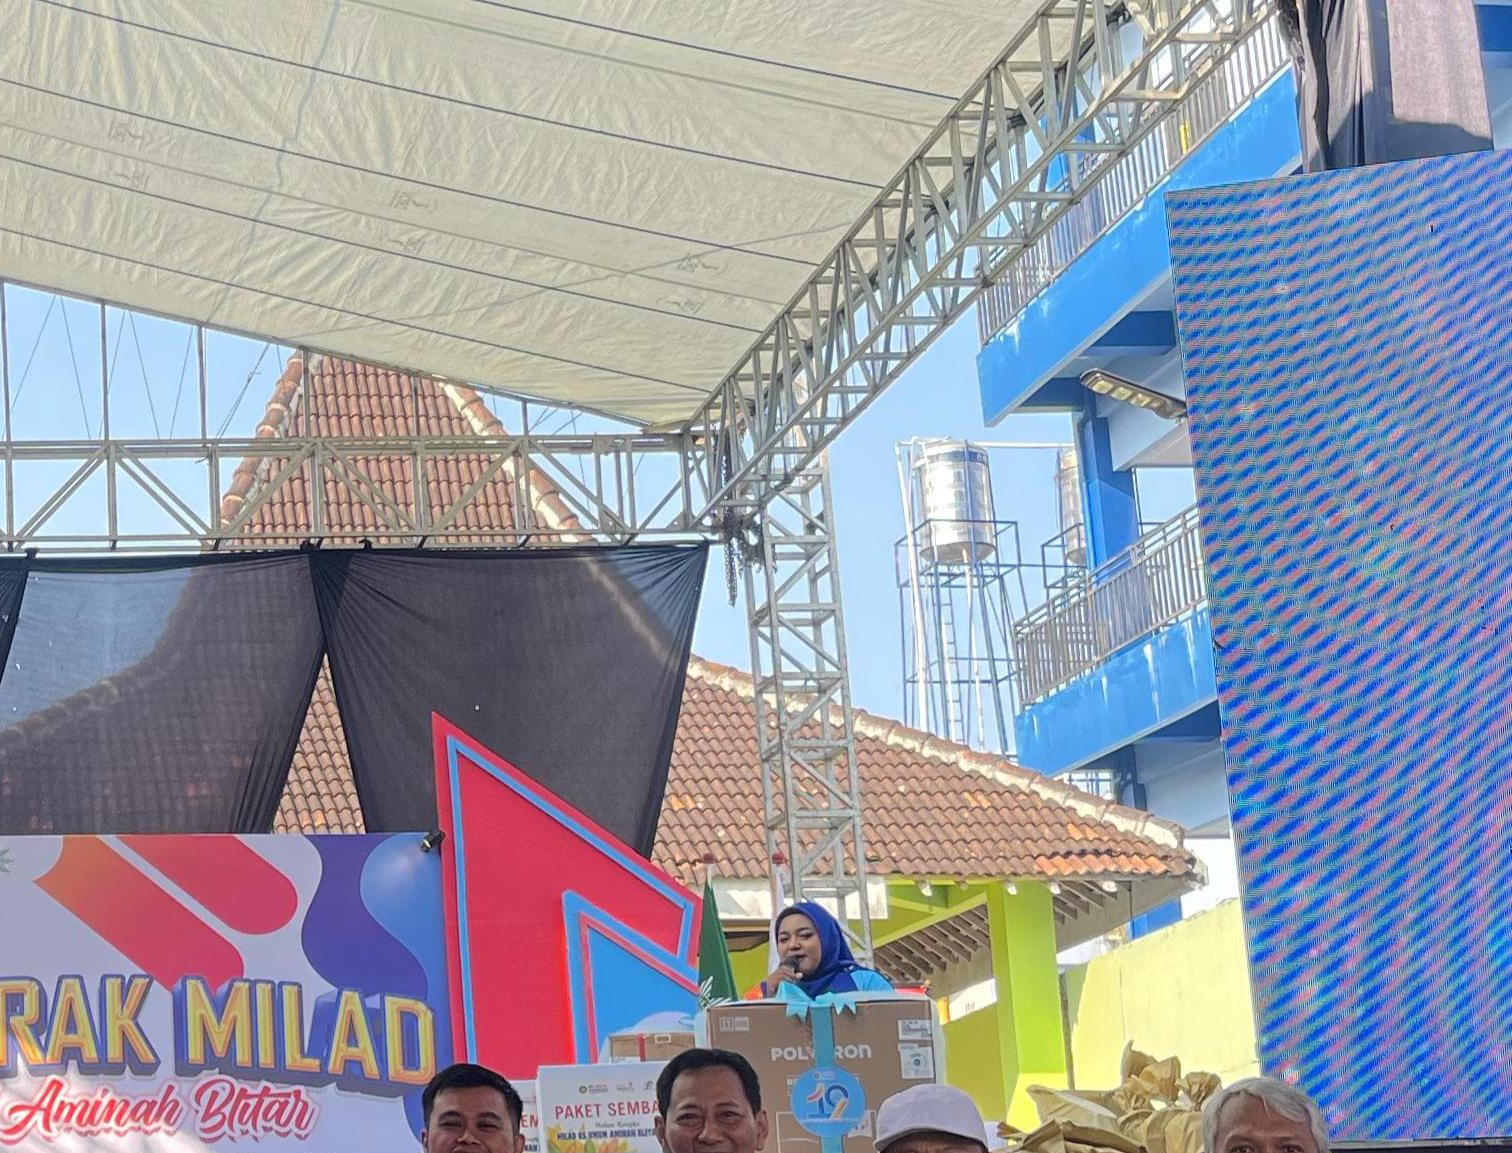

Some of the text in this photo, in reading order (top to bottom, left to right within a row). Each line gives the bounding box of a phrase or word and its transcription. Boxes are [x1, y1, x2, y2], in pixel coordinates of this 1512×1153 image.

[172, 974, 442, 1095] MILAD
[4, 1077, 185, 1143] Aminah
[555, 1100, 659, 1120] PAKET SEMBA
